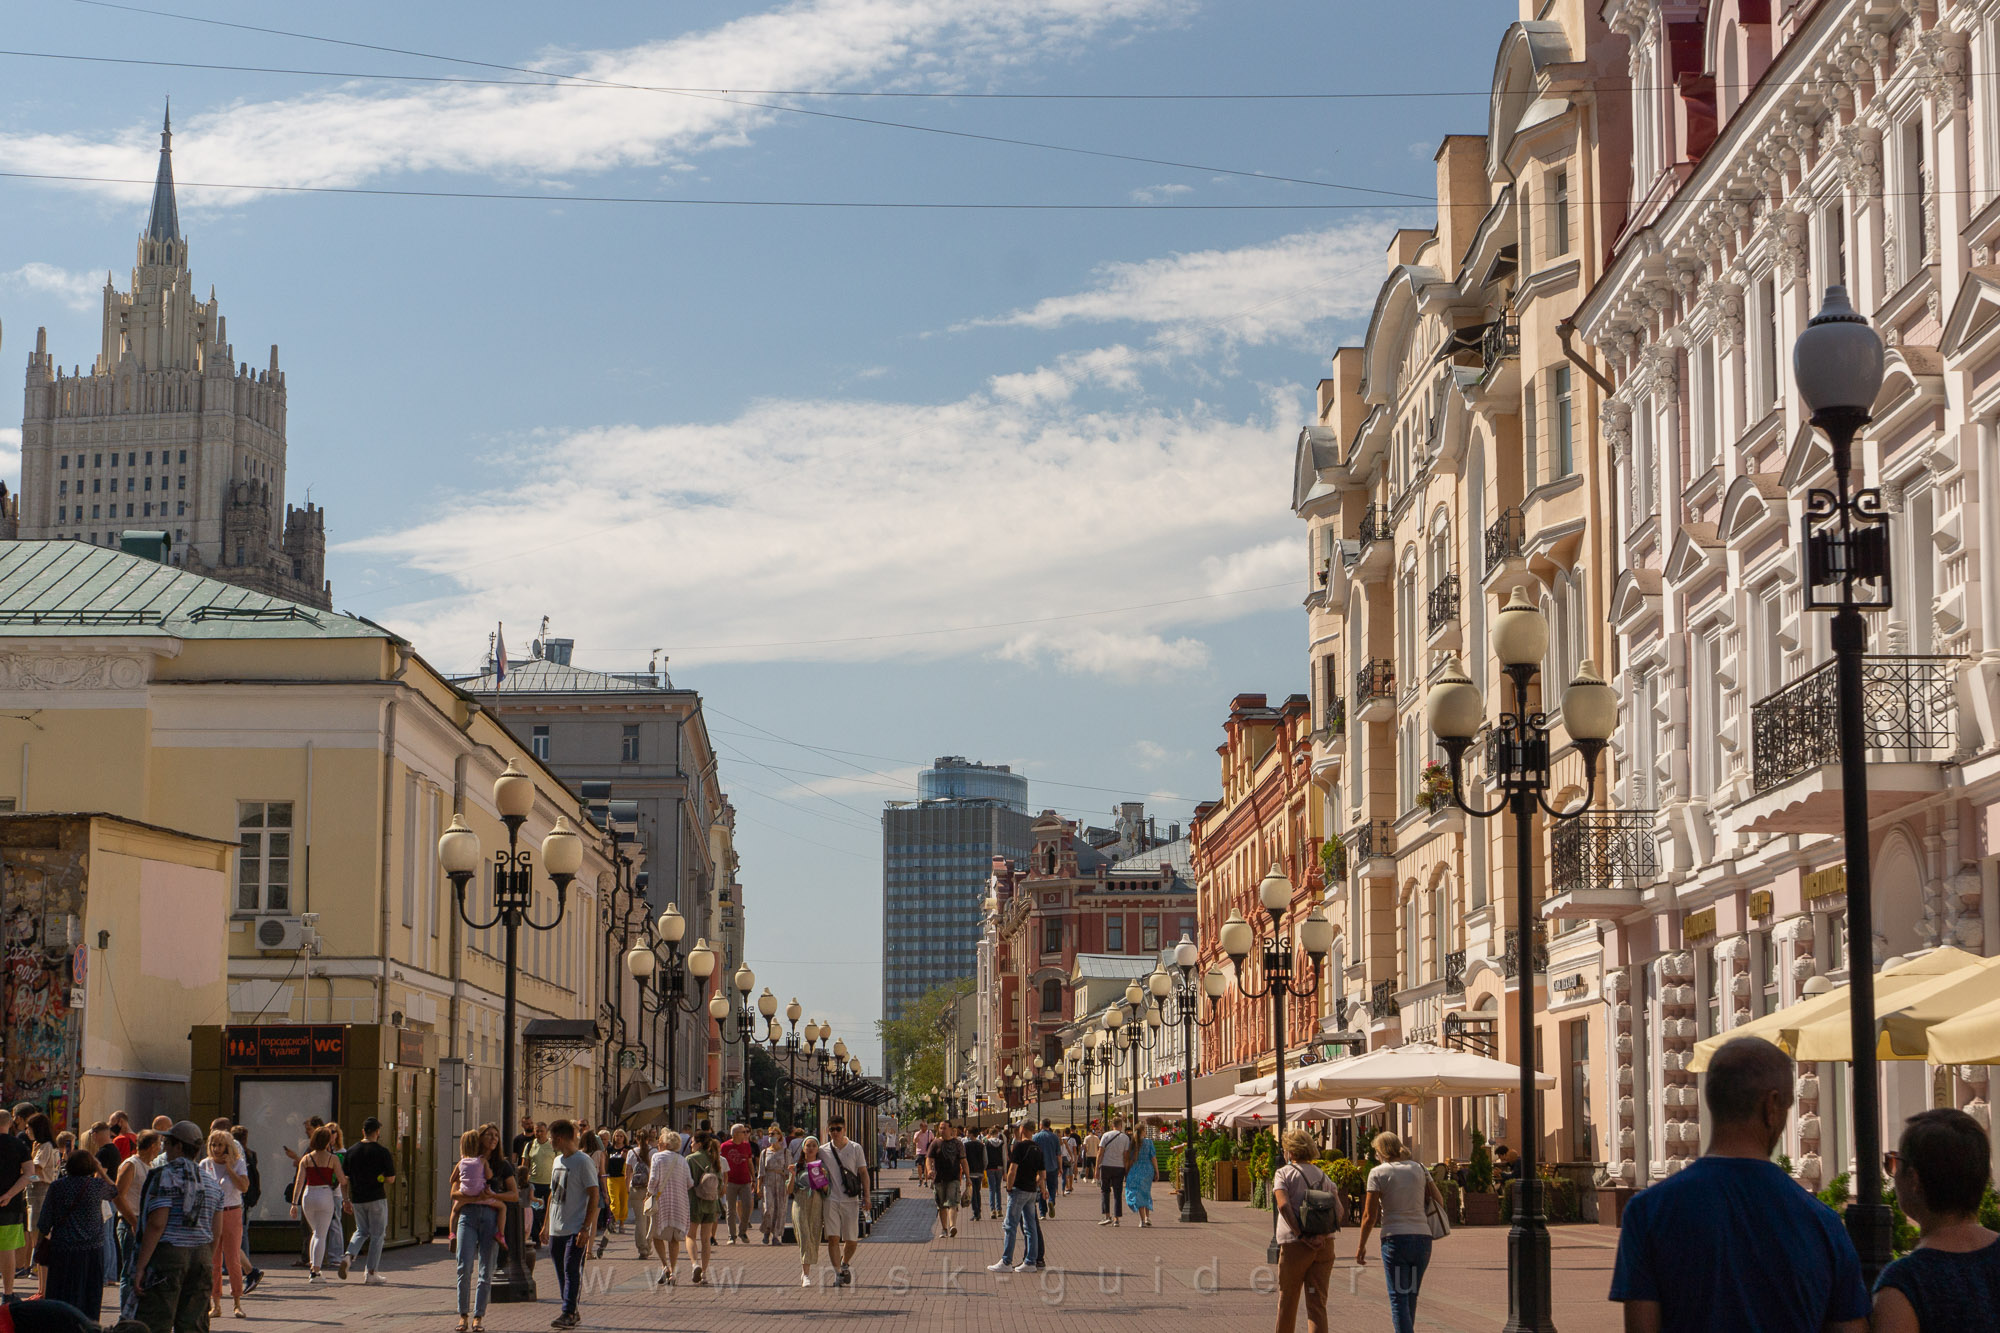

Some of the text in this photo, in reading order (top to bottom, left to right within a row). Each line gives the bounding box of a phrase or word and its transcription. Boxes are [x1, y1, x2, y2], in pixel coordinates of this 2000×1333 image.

[261, 1035, 310, 1047] городской
[314, 1039, 342, 1052] WC
[270, 1047, 300, 1057] туалет
